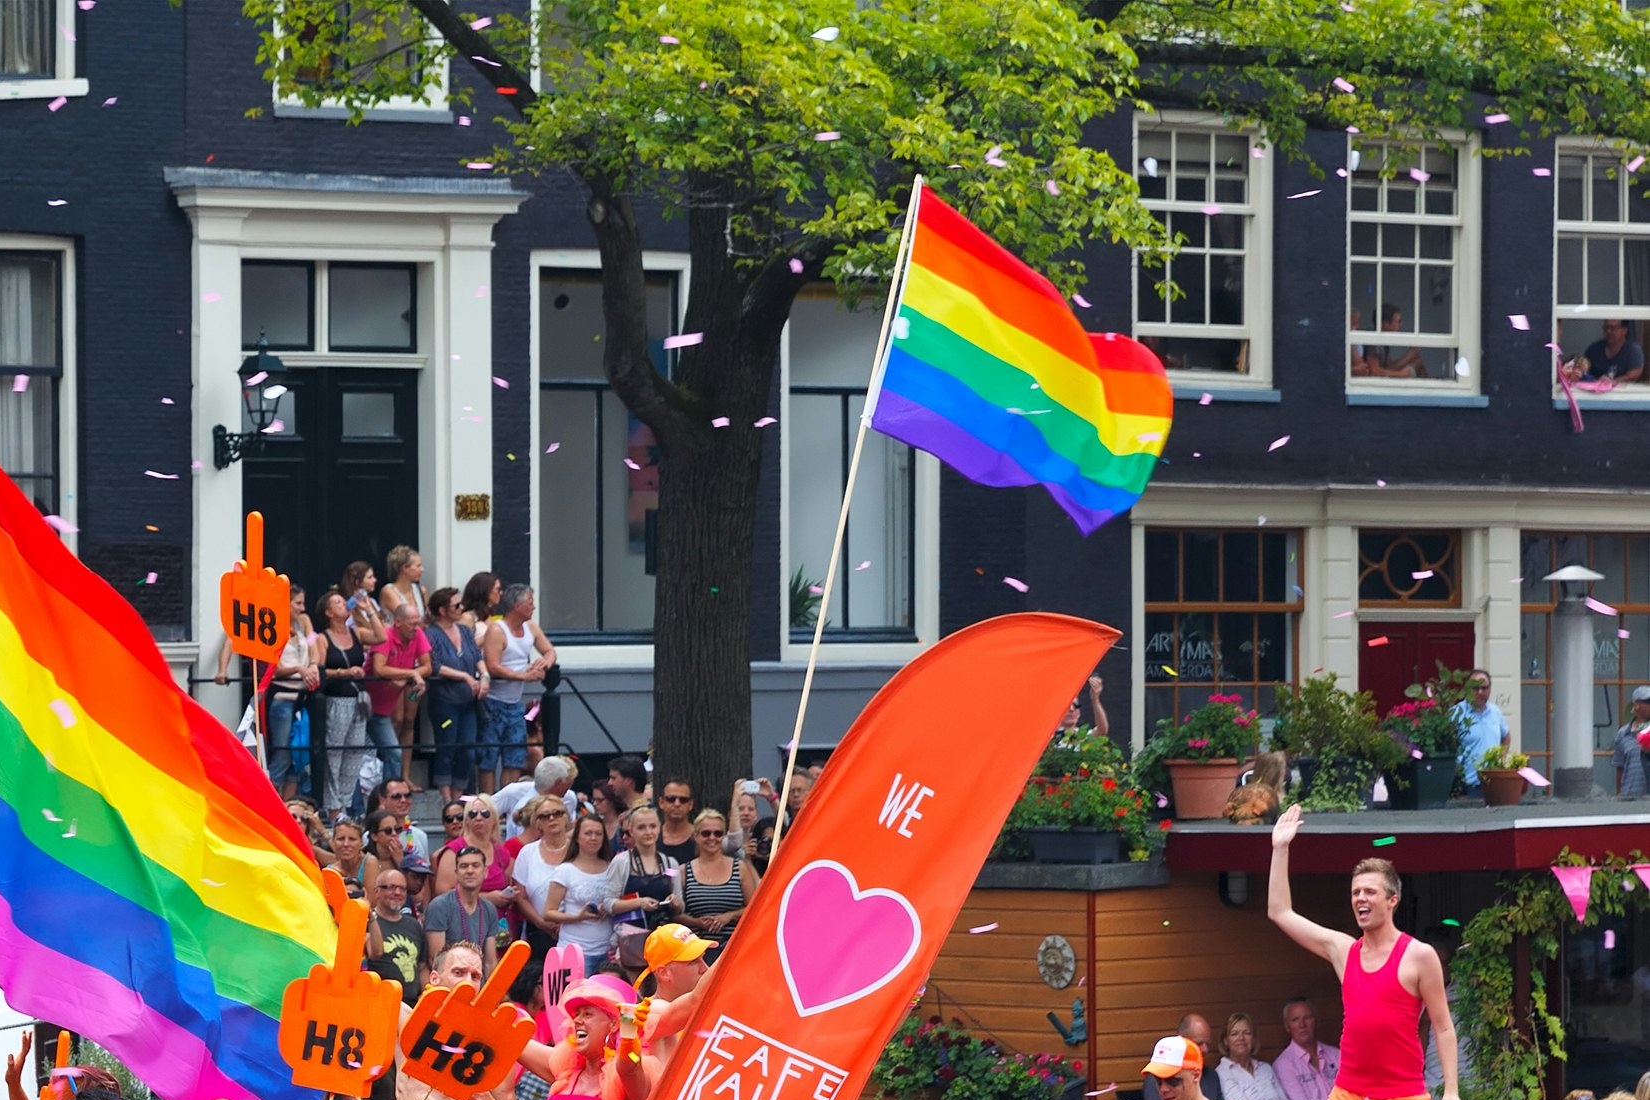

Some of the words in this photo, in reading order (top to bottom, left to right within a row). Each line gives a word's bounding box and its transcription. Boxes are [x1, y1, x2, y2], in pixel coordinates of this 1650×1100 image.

[232, 598, 278, 647] H8
[878, 772, 936, 839] WE
[547, 967, 572, 1007] WE
[302, 1019, 366, 1071] H8
[408, 1020, 495, 1087] H8
